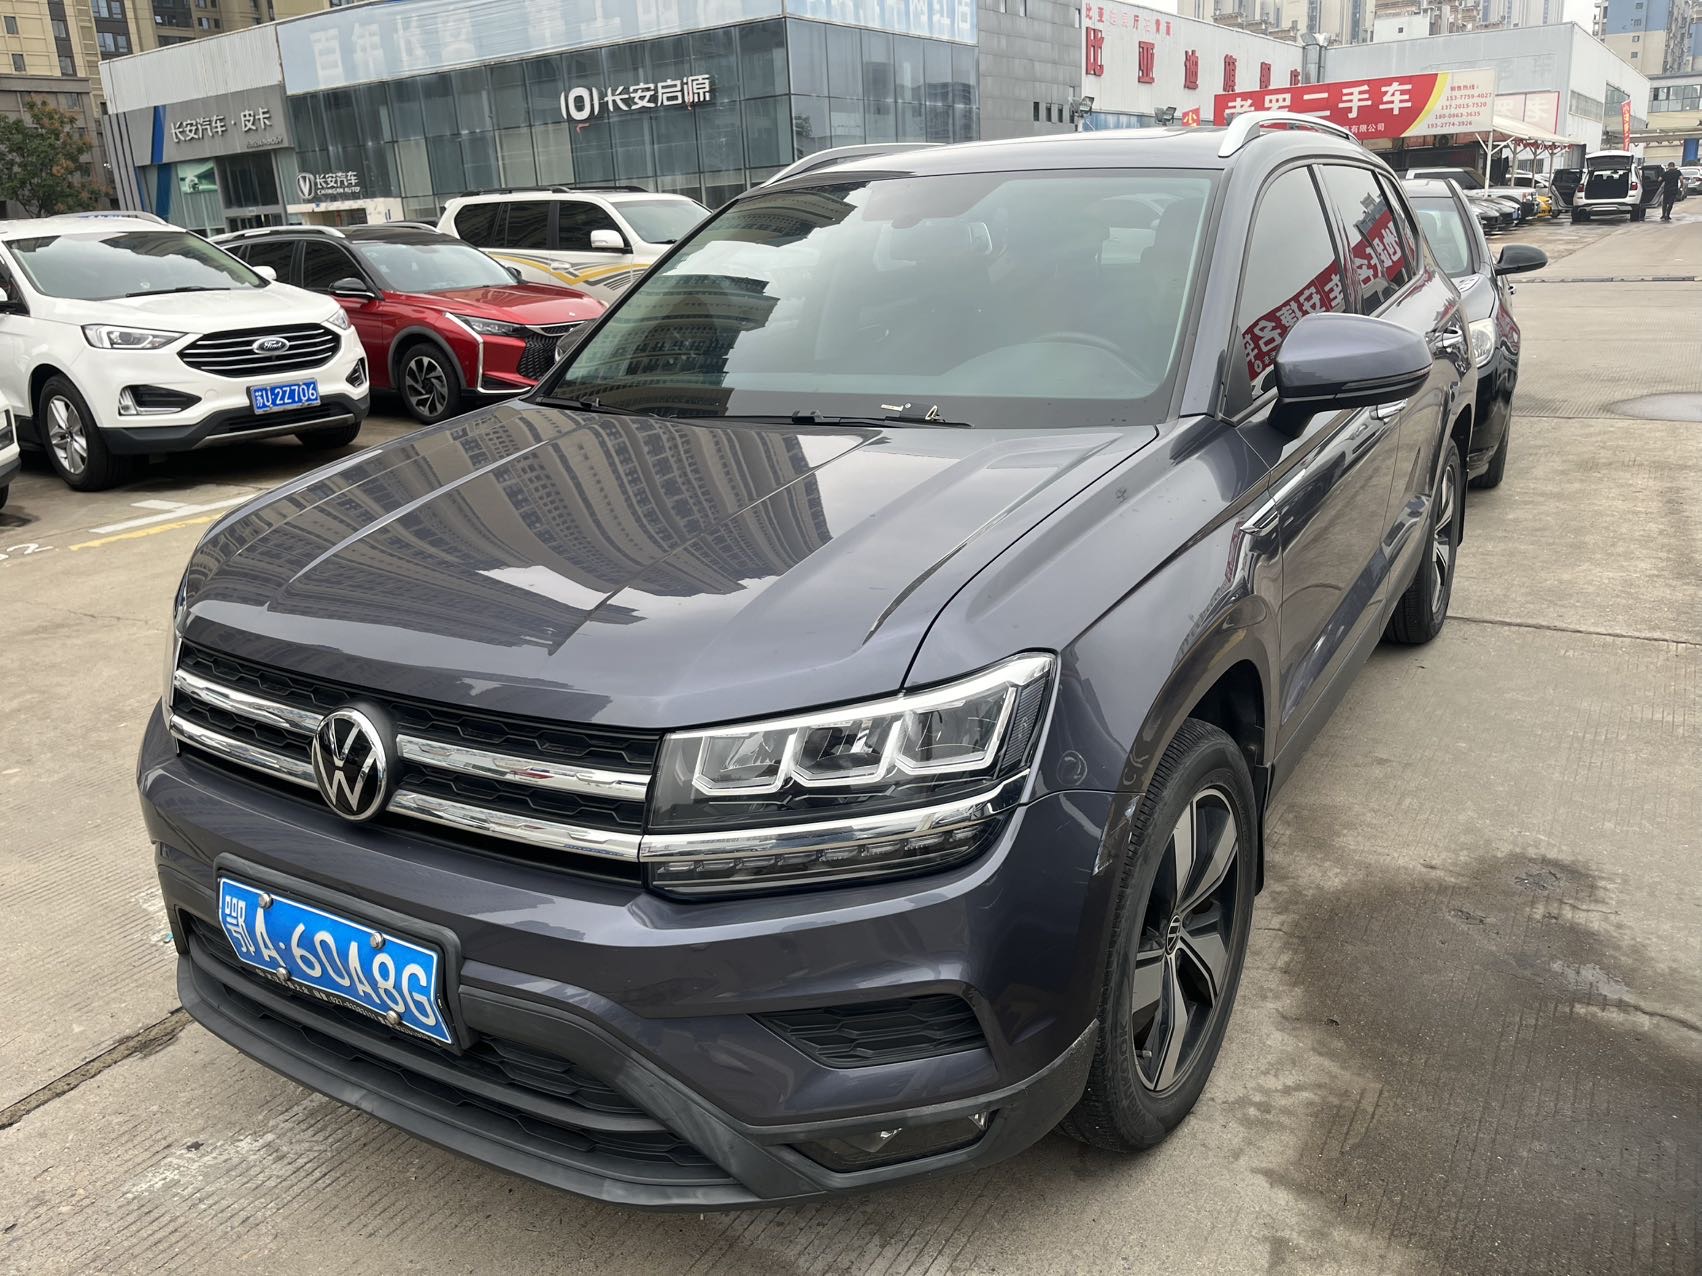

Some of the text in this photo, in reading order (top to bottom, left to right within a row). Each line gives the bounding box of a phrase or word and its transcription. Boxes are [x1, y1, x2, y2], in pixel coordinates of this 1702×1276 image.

[604, 74, 711, 112] 长安启源
[316, 170, 359, 189] 长安汽车
[317, 186, 360, 196] CHANGAN AUTO
